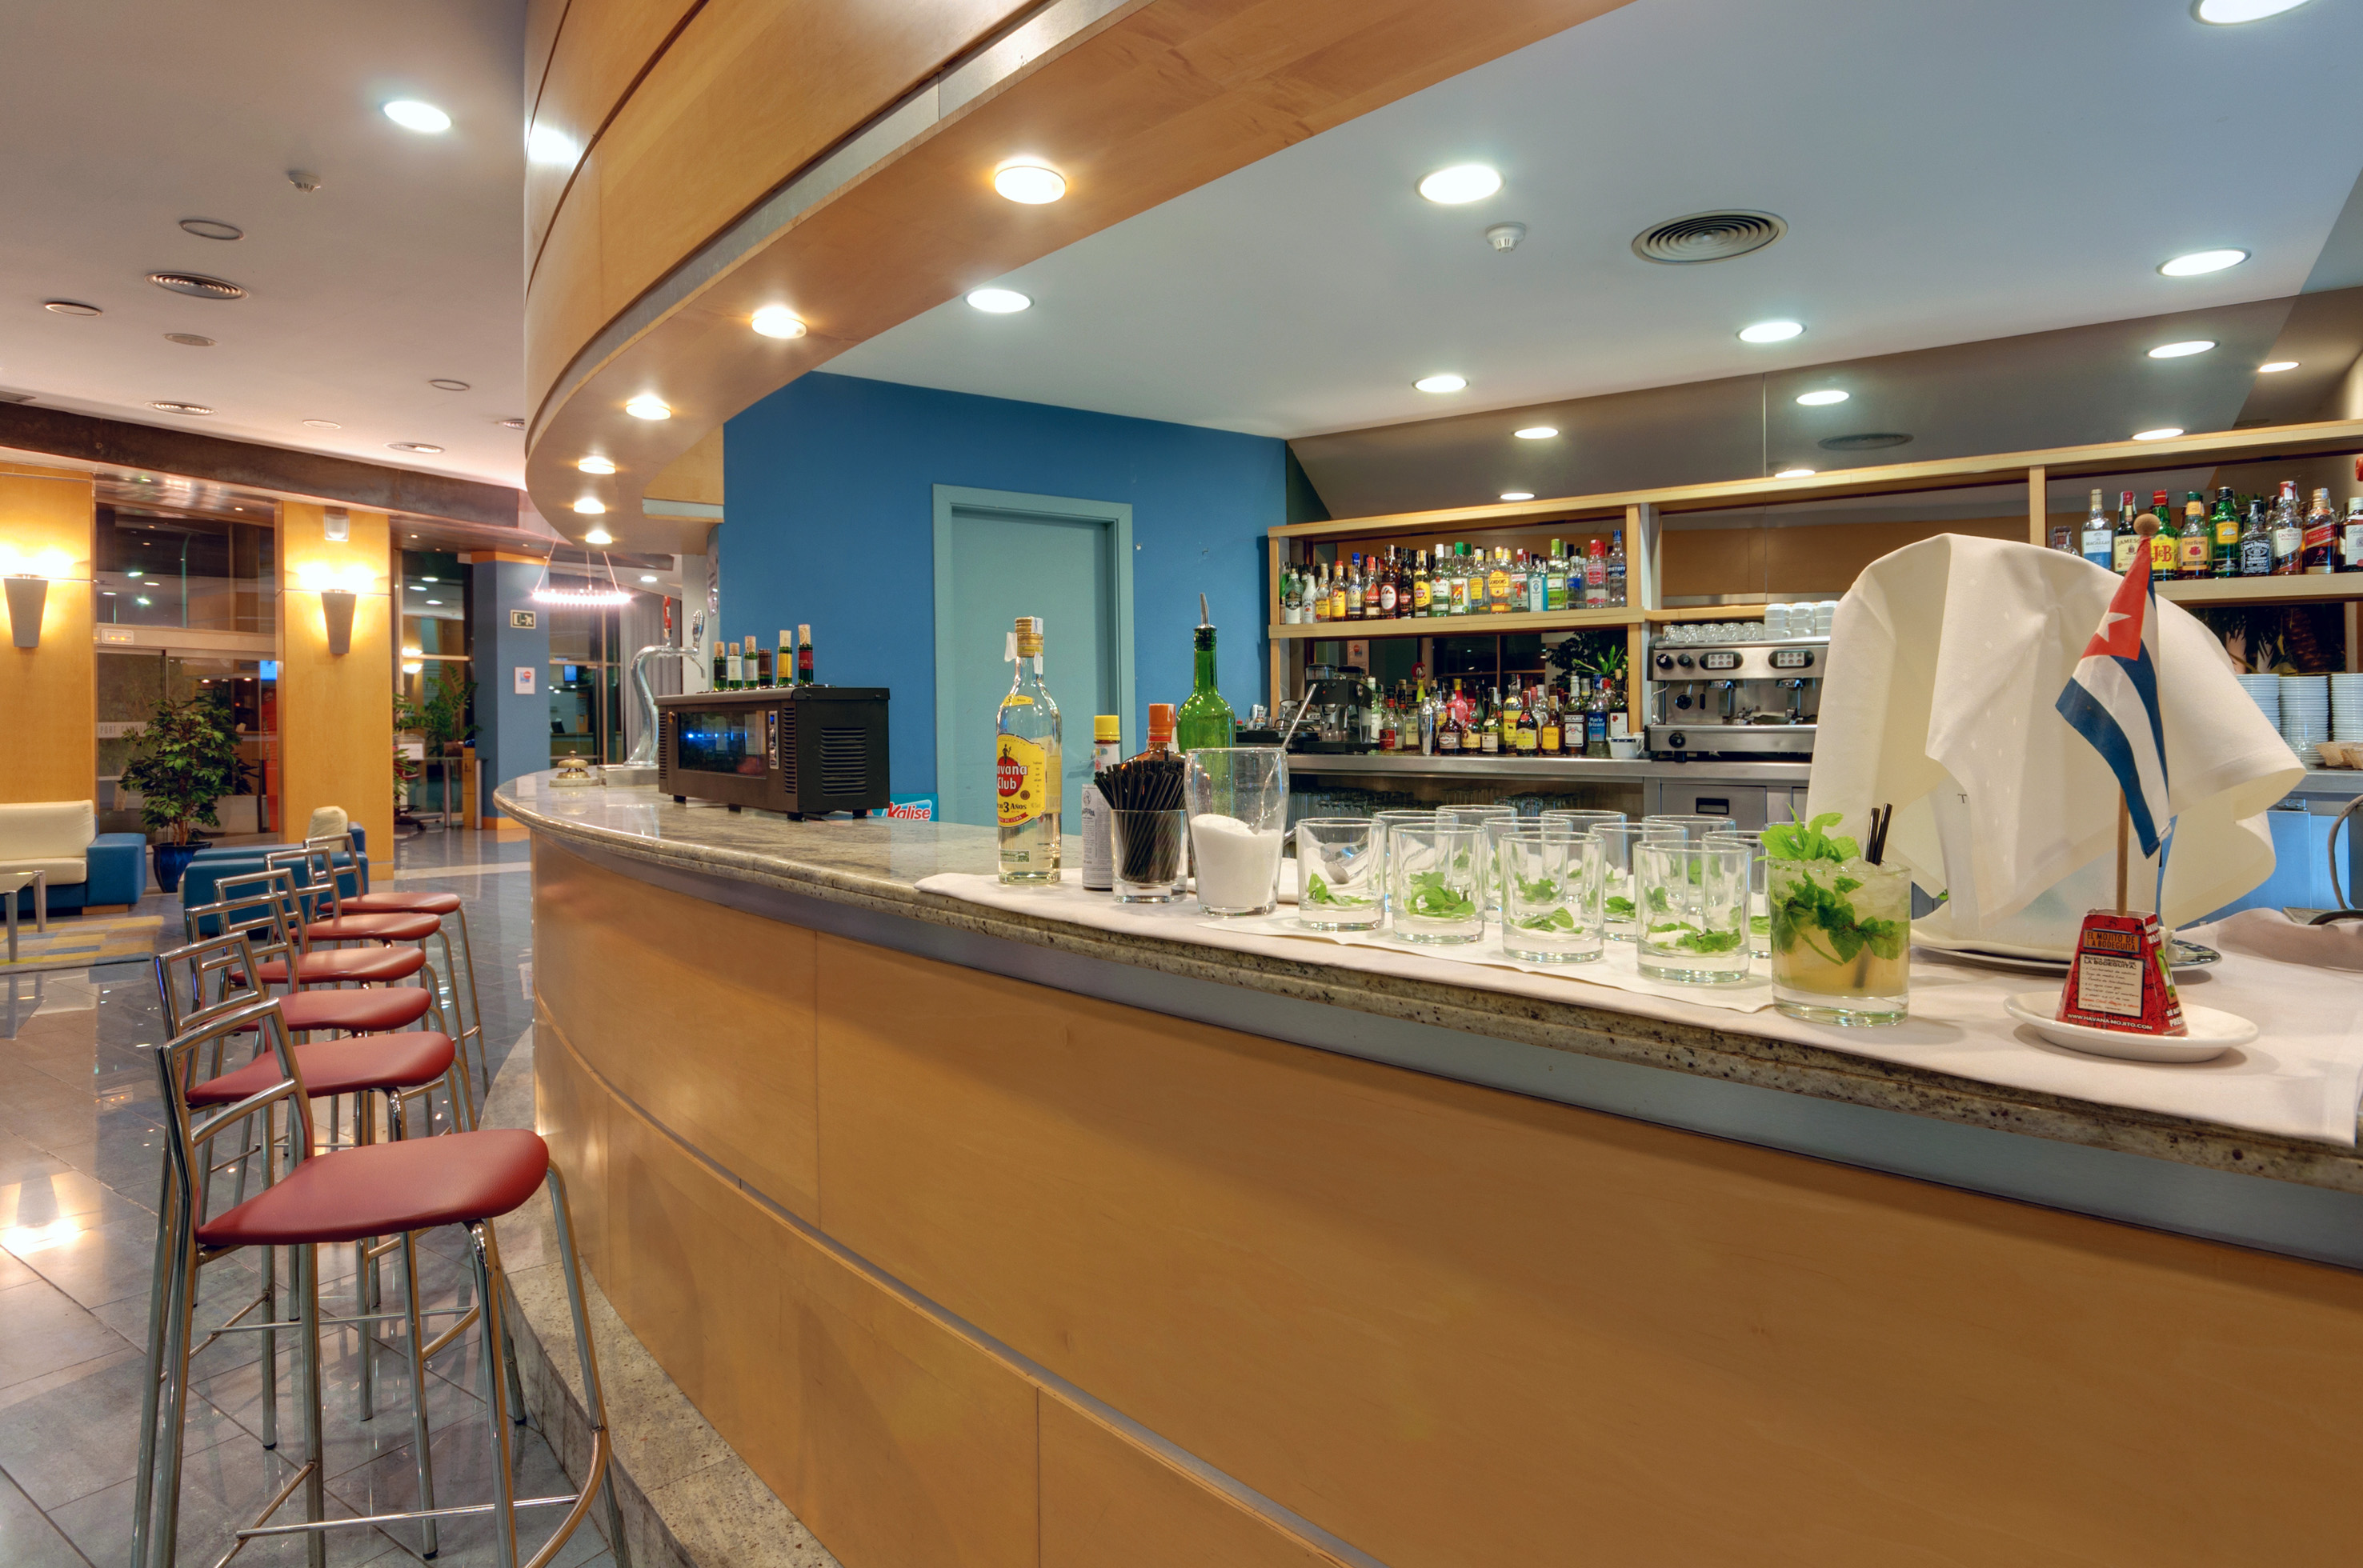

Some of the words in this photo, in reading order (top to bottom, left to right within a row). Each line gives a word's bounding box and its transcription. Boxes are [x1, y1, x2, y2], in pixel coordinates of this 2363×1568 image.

[887, 802, 931, 820] Kalise
[1003, 801, 1010, 813] 3
[2087, 931, 2093, 940] EL
[2097, 932, 2123, 942] MOJITO
[2125, 934, 2135, 944] DE
[2086, 939, 2096, 947] LA
[2098, 940, 2136, 951] BODEGUITA
[2067, 1013, 2153, 1030] WWW.HAVANA-MOJITO.COM
